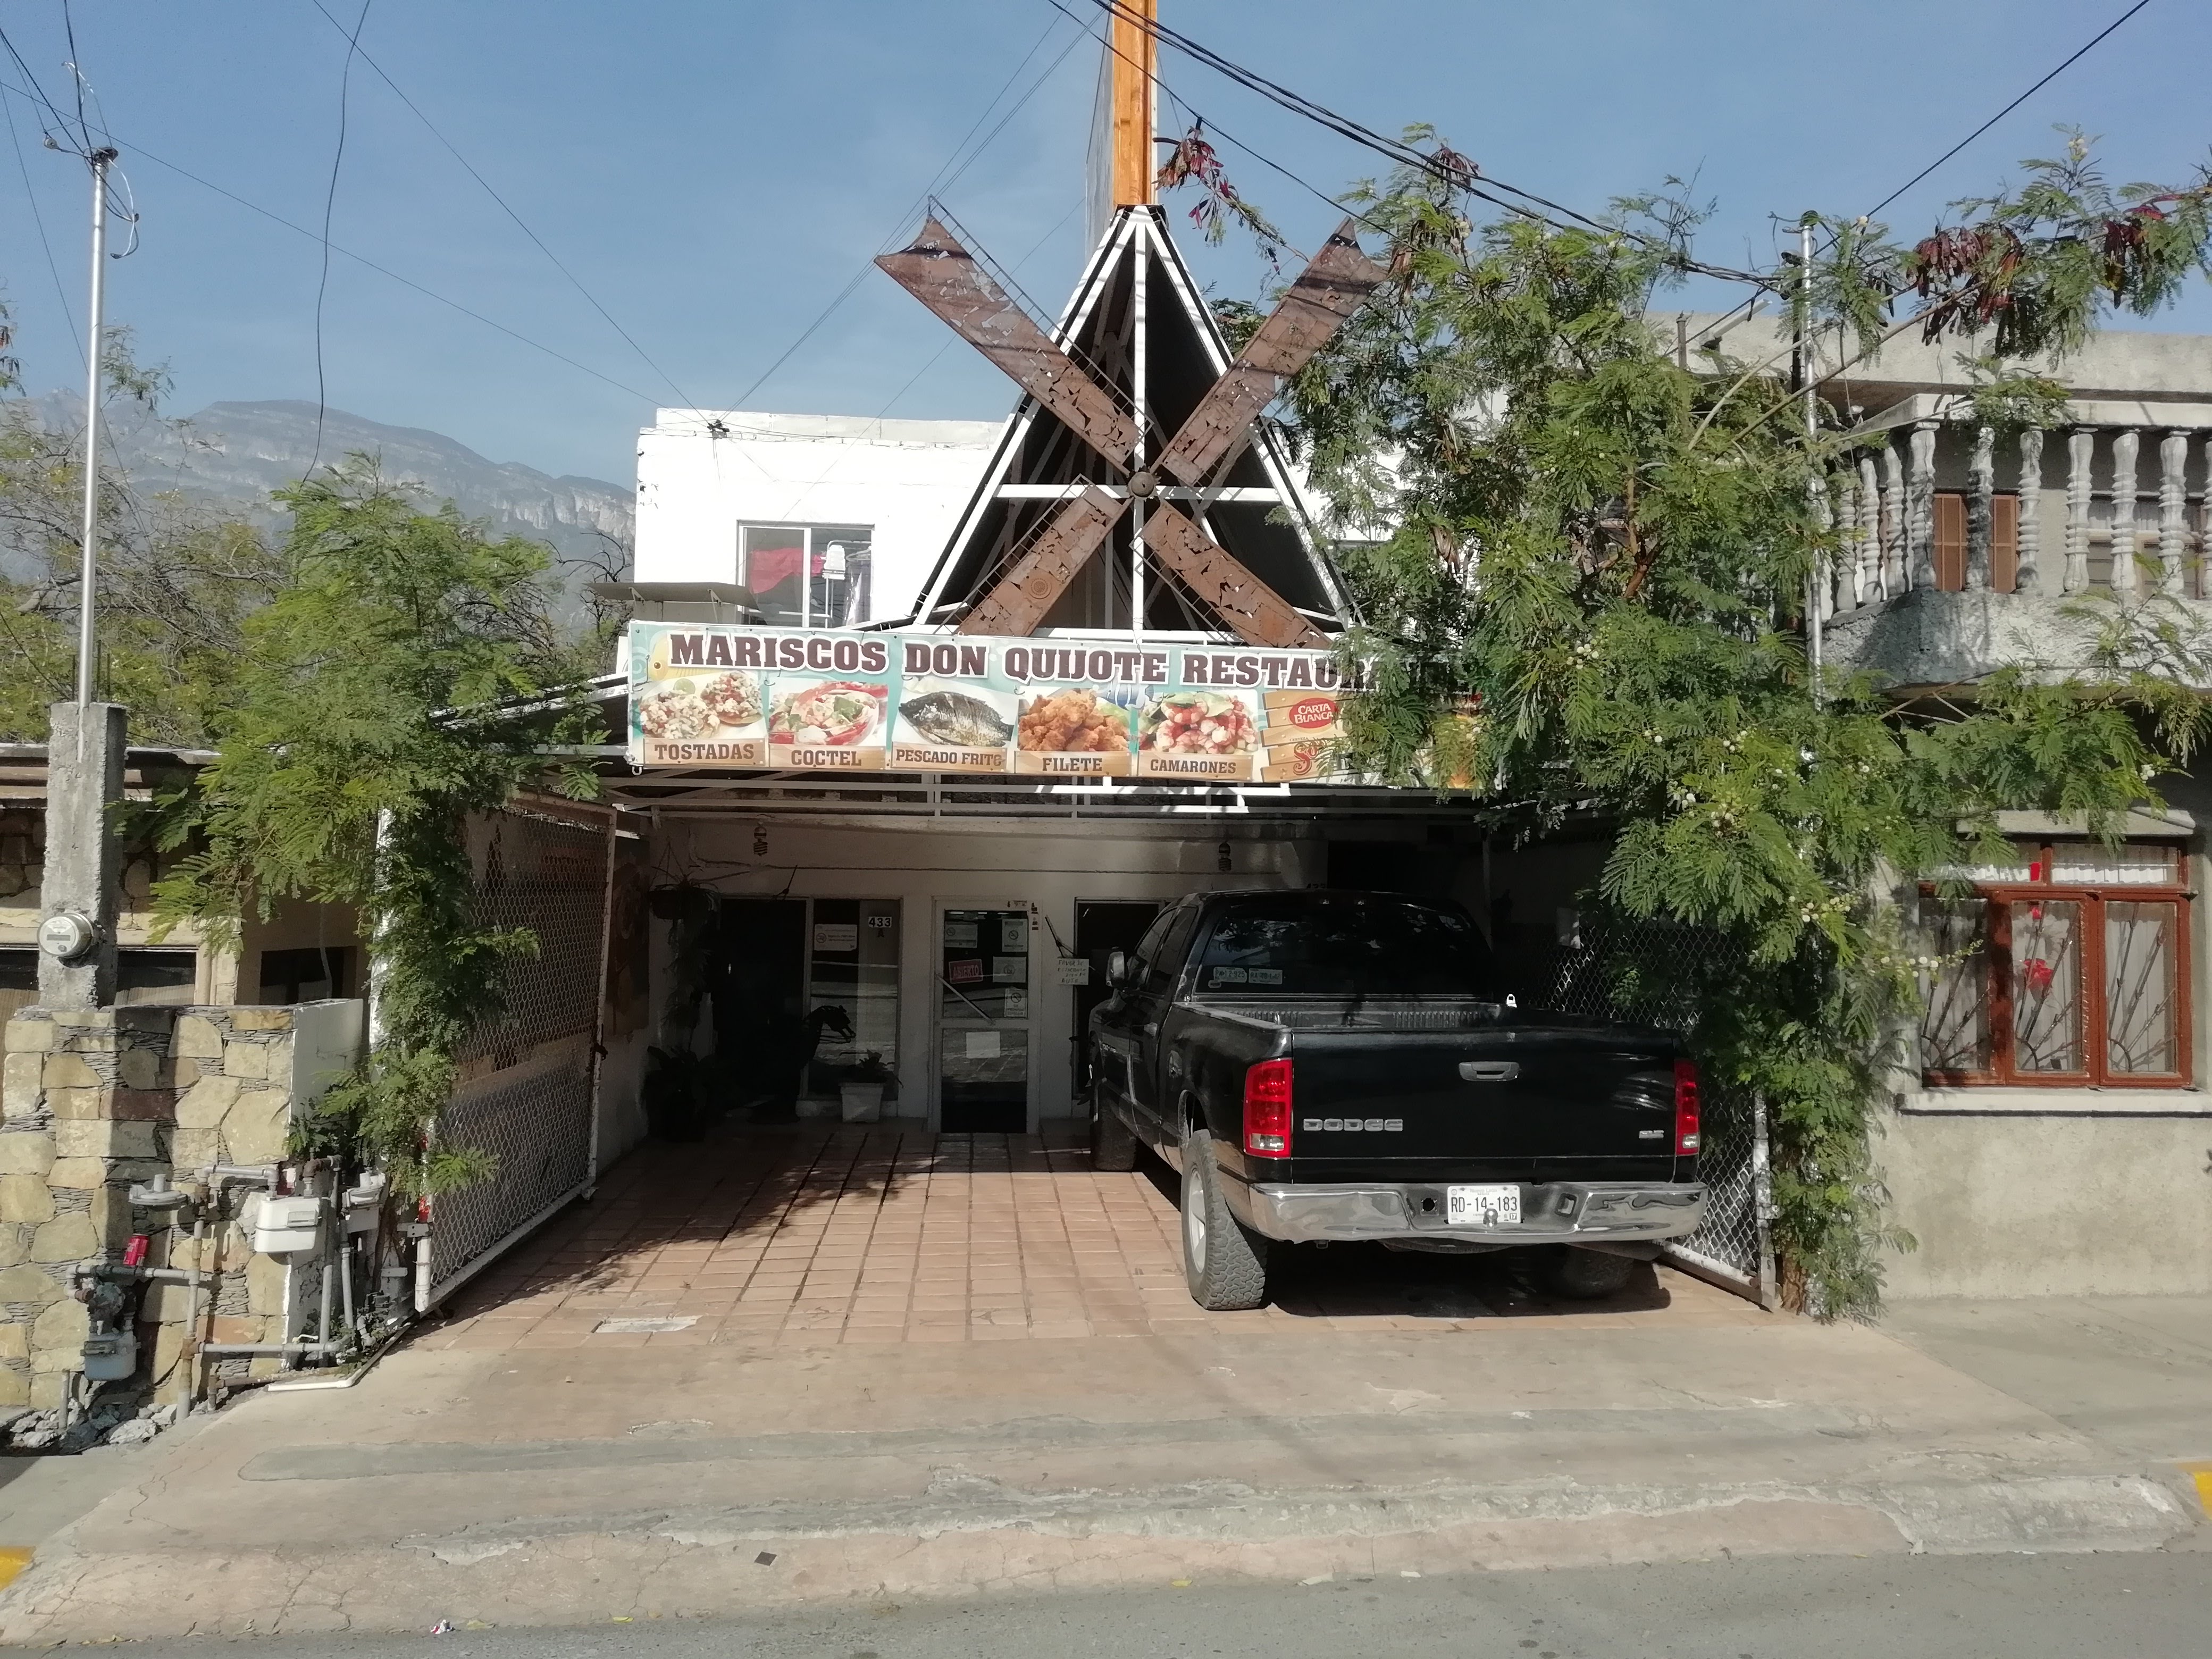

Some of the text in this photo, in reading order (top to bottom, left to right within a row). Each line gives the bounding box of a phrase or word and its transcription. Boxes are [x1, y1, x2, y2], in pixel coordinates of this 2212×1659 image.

[670, 634, 887, 672] MARISCOS
[905, 643, 987, 675] DON
[1005, 647, 1168, 683] QUIJOTE
[1297, 703, 1331, 715] CARTA
[1294, 711, 1333, 724] BLANCA
[654, 743, 755, 761] TOSTADAS
[791, 750, 862, 766] COCTEL
[896, 749, 1003, 766] PESCADO FRITO
[1042, 757, 1103, 772] FILETE
[1150, 759, 1236, 774] CAMARONES
[869, 917, 891, 927] 433
[952, 964, 979, 979] ABIERTO
[1303, 1118, 1403, 1131] DODGE
[1451, 1196, 1517, 1212] RD-14-183
